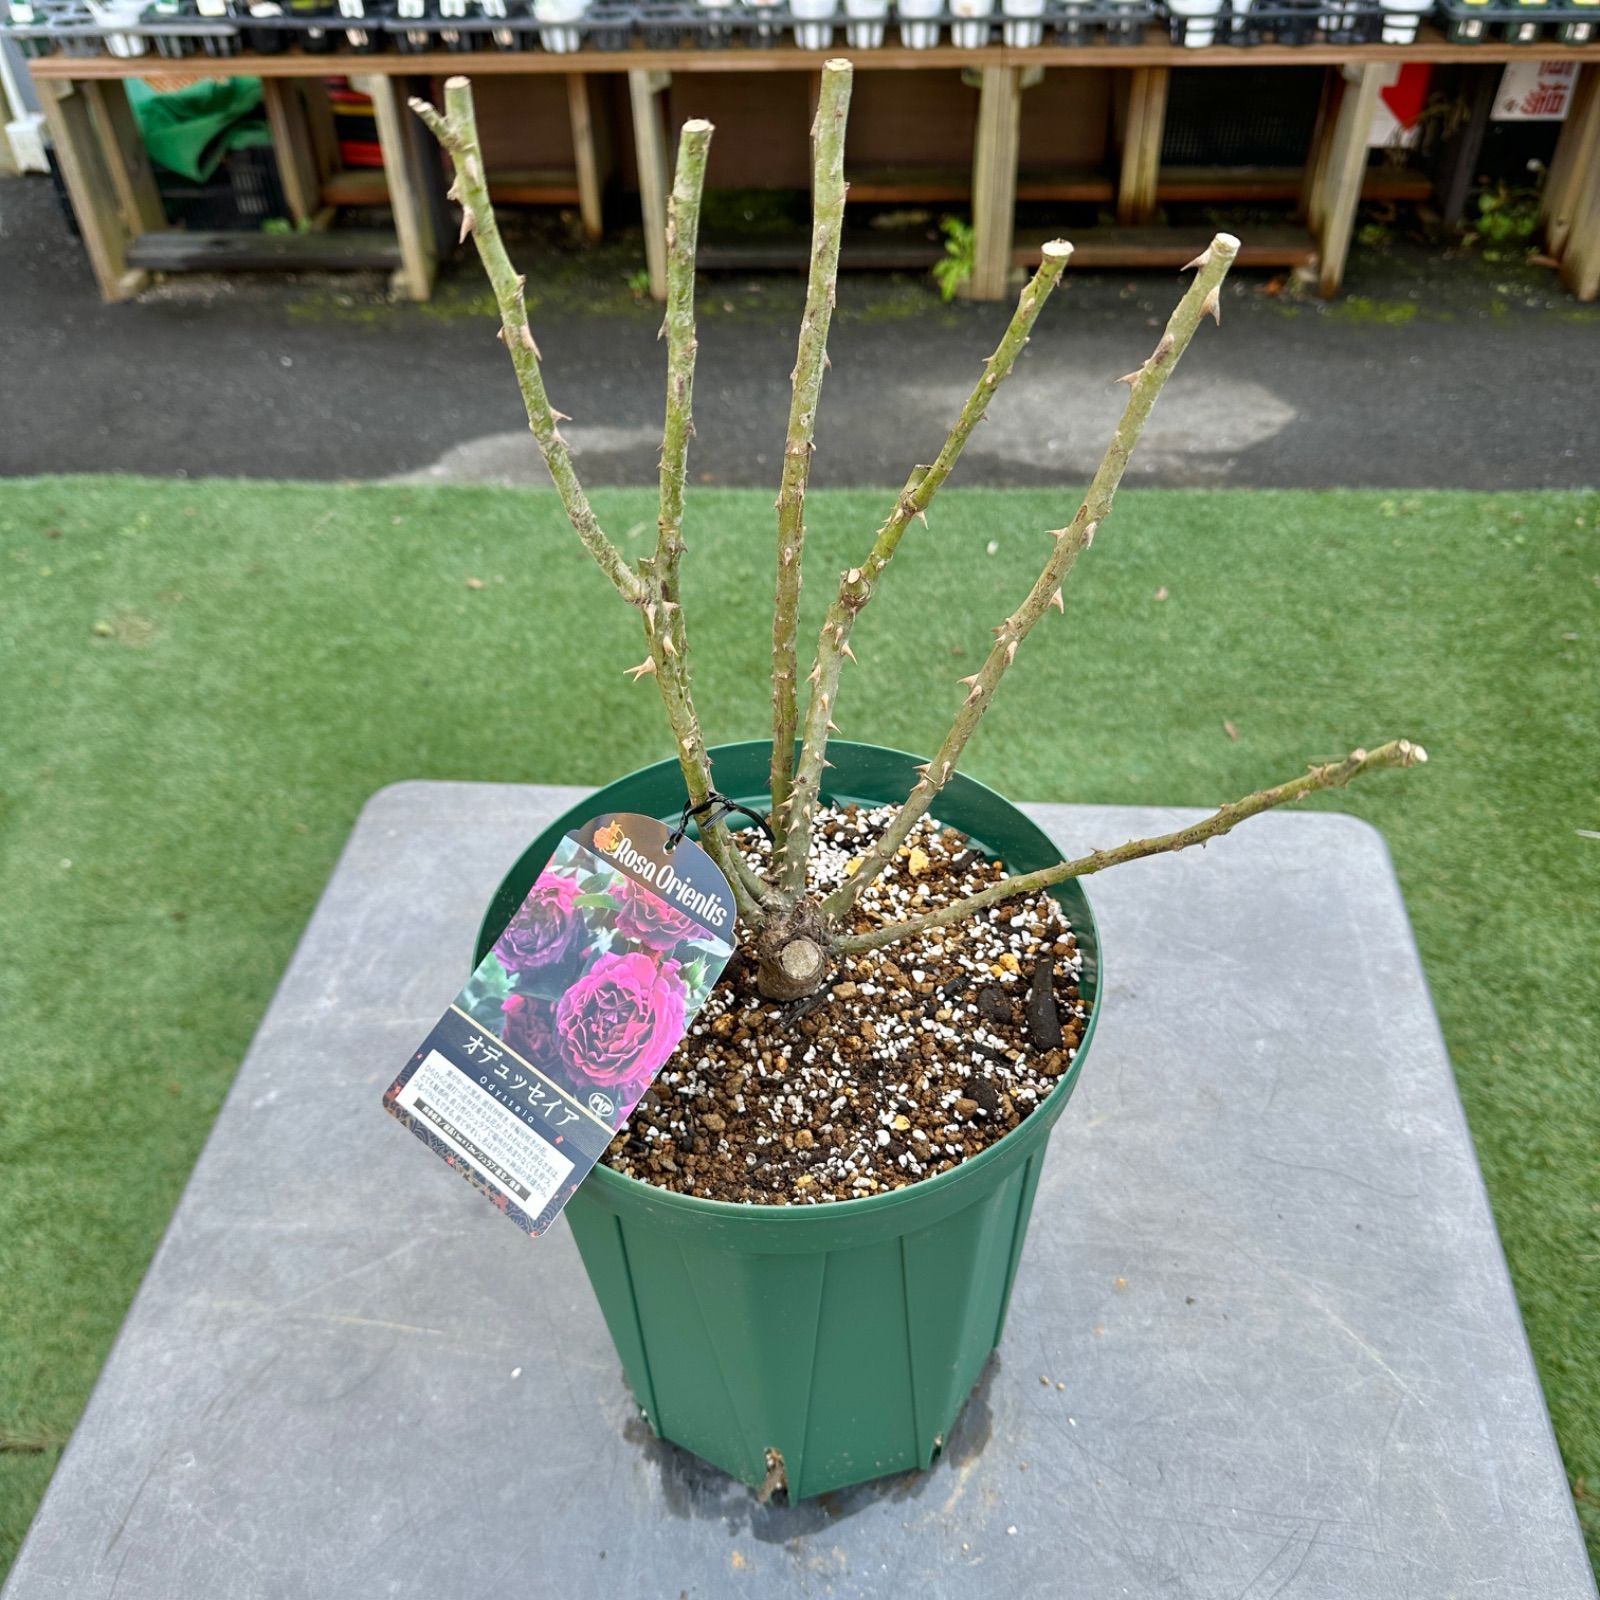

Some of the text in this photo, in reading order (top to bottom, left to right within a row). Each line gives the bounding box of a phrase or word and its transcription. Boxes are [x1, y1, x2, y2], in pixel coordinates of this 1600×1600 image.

[613, 837, 727, 927] Rosa Orientis
[462, 1035, 580, 1126] オデュッセイア
